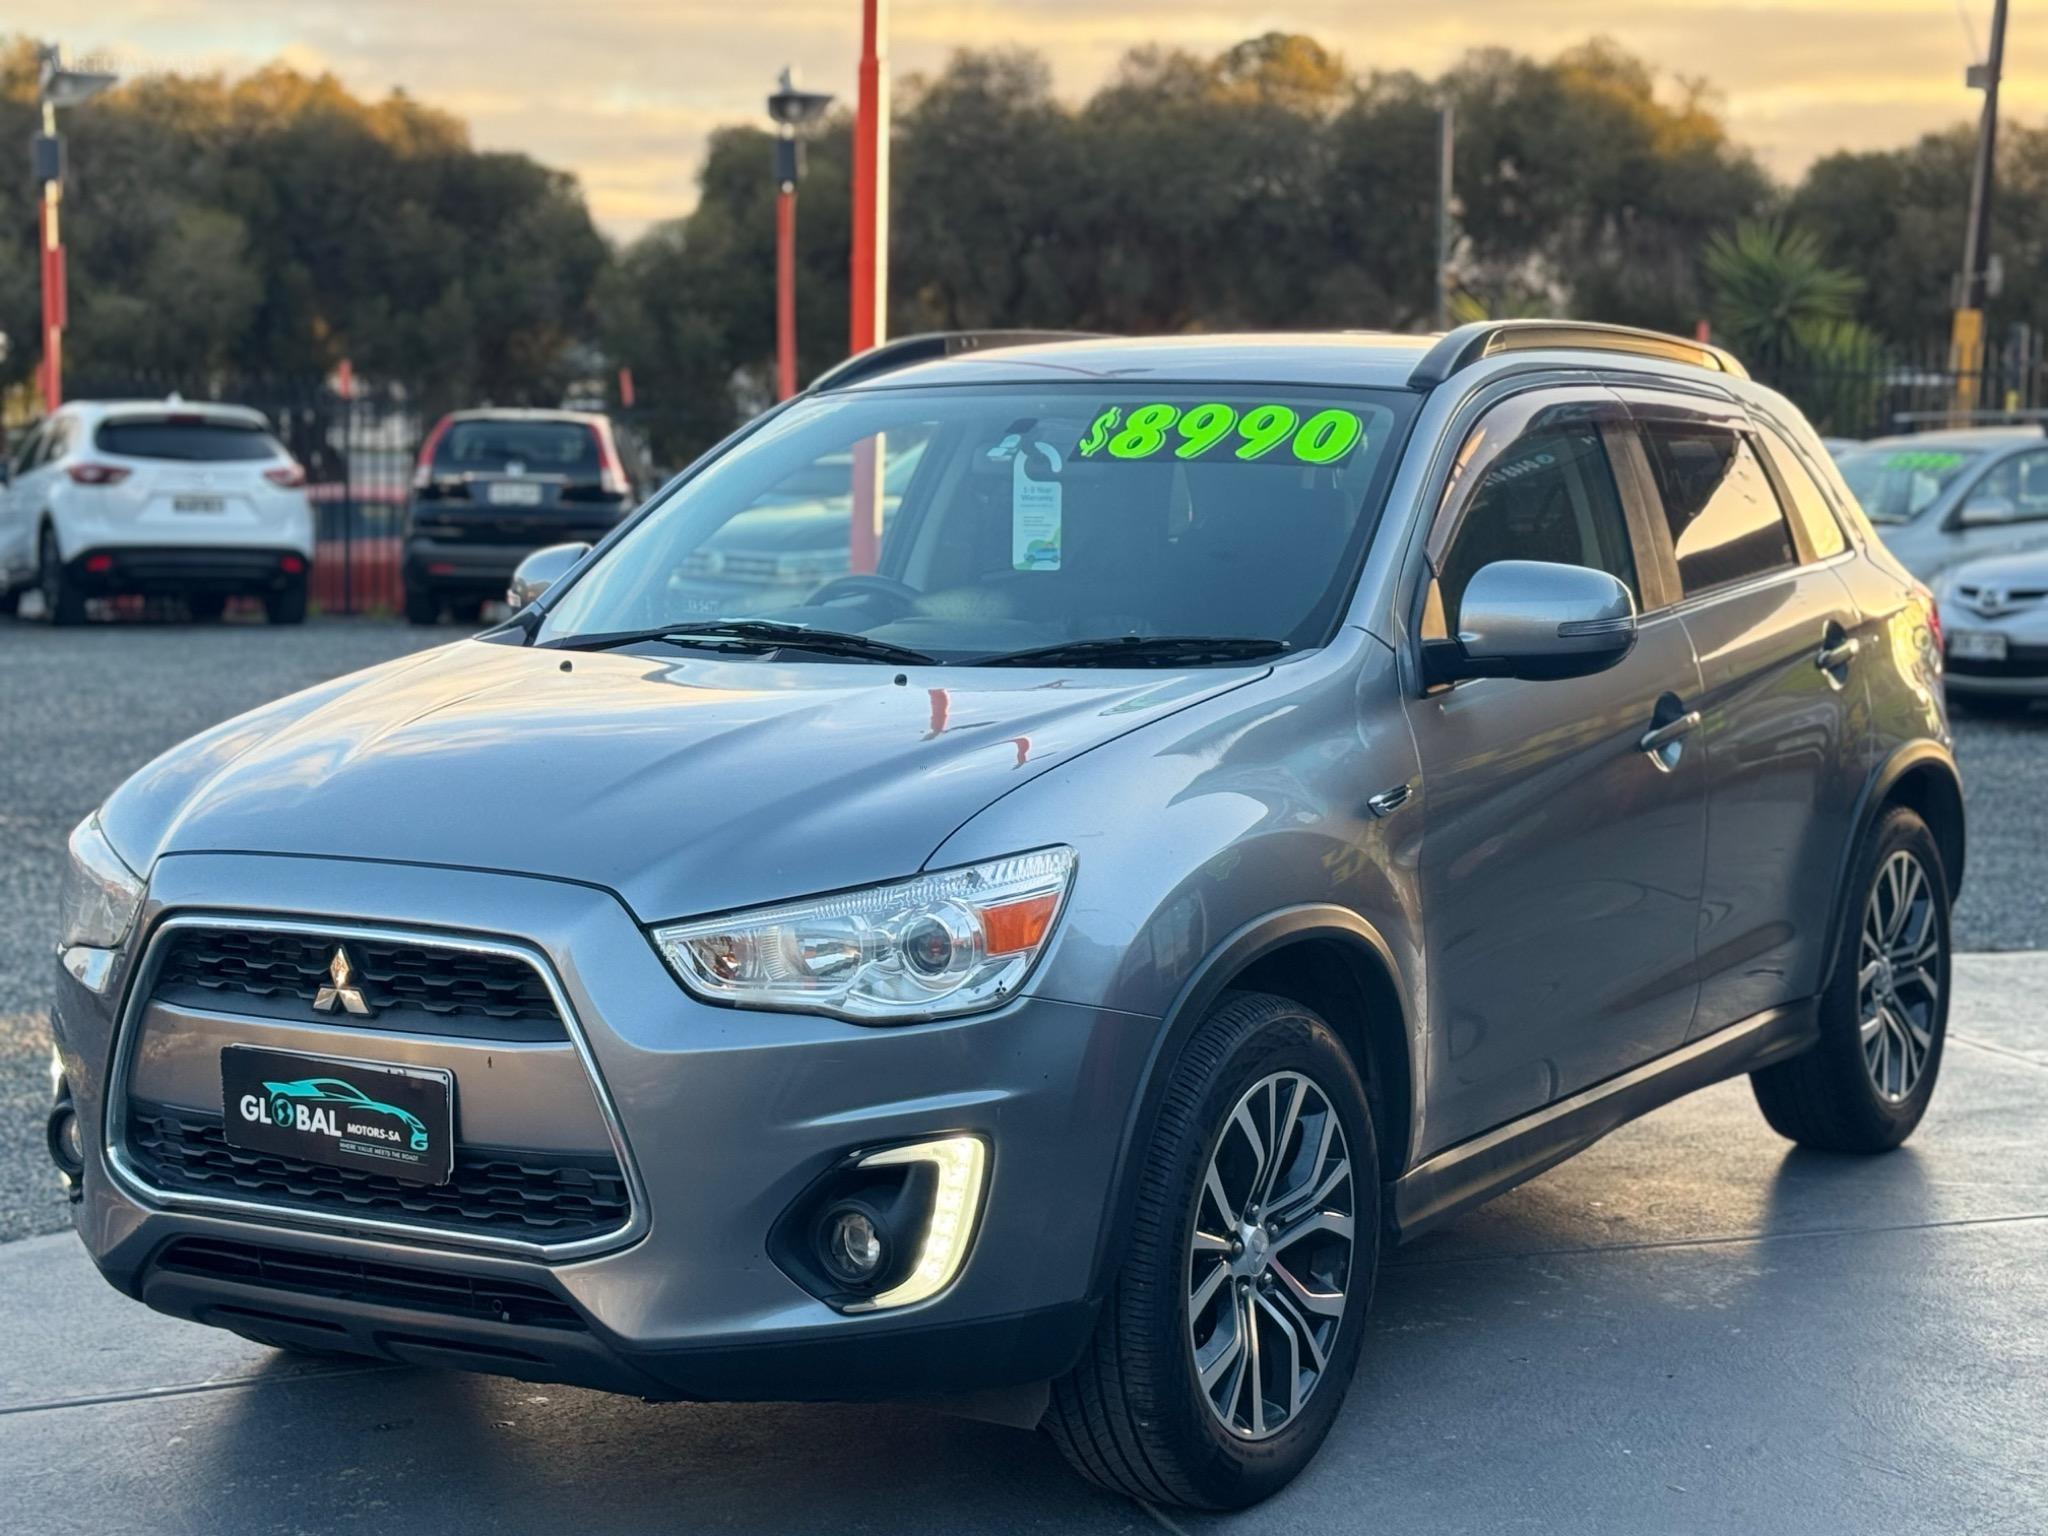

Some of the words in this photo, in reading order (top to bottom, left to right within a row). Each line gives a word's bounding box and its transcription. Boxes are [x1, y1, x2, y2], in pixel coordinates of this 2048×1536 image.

[1079, 402, 1364, 464] $8990
[240, 1095, 341, 1137] GLOBAL
[347, 1122, 401, 1142] MOTORS-SA
